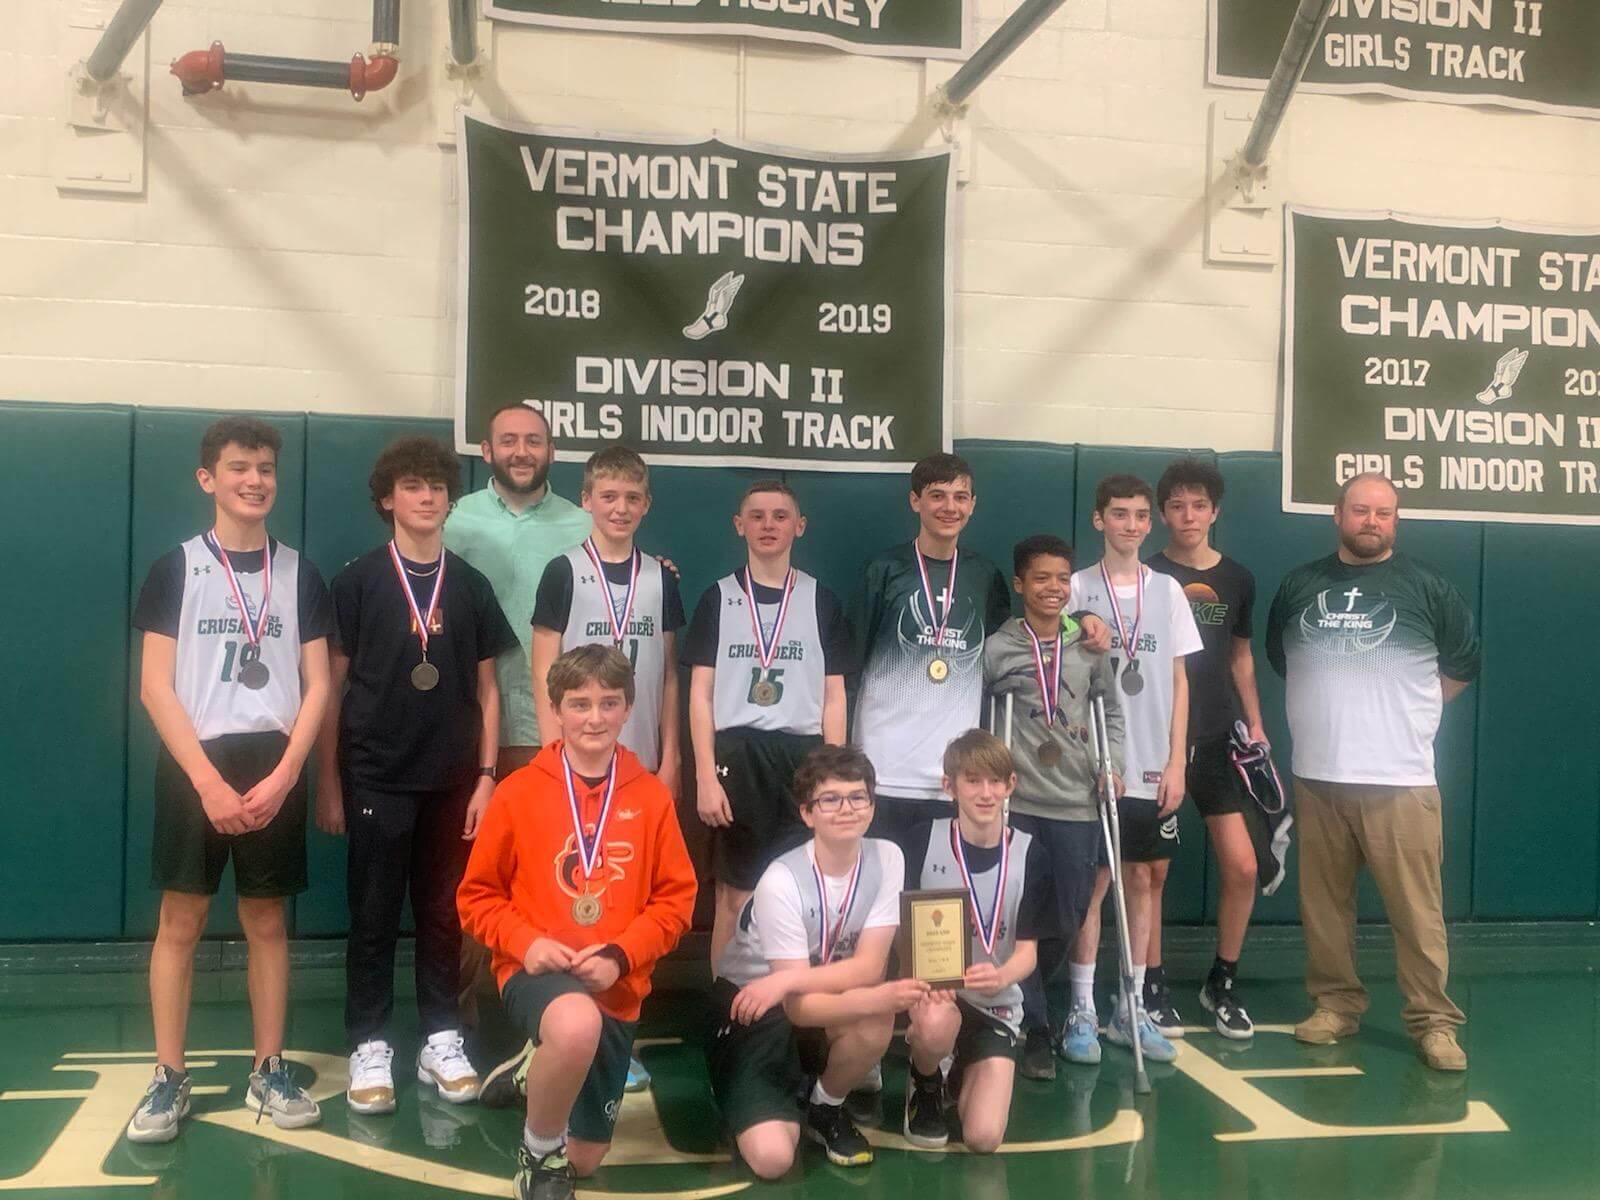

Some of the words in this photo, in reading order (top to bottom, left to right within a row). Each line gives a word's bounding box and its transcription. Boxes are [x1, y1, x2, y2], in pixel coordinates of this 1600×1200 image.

[720, 0, 888, 29] KEY
[1329, 0, 1493, 30] IVISION
[1513, 1, 1543, 37] II
[1324, 33, 1411, 71] GIRLS
[1425, 42, 1526, 82] TRACK
[519, 146, 738, 200] VERMONT
[757, 165, 898, 213] STATE
[556, 206, 865, 266] CHAMPIONS
[1336, 237, 1520, 287] VERMONT
[524, 284, 600, 319] 2018
[818, 303, 891, 334] 2019
[1340, 294, 1600, 348] CHAMPION
[576, 356, 790, 400] DIVISION
[811, 368, 844, 403] II
[1364, 357, 1430, 386] 2017
[1564, 368, 1600, 396] 20
[522, 399, 622, 439] IRLS
[641, 405, 764, 444] INDOOR
[782, 412, 895, 450] TRACK
[1384, 407, 1564, 446] DIVISION
[1335, 453, 1424, 489] GIRLS
[1440, 456, 1544, 493] INDOOR
[1560, 461, 1600, 494] TR
[198, 618, 282, 638] CRUSARS
[586, 621, 655, 637] CRUDERS
[1318, 619, 1340, 628] THE
[1343, 619, 1373, 629] KING
[1325, 612, 1368, 620] CHRIST
[728, 643, 804, 661] CRUSDERS
[942, 637, 967, 650] KING
[747, 667, 785, 705] 15
